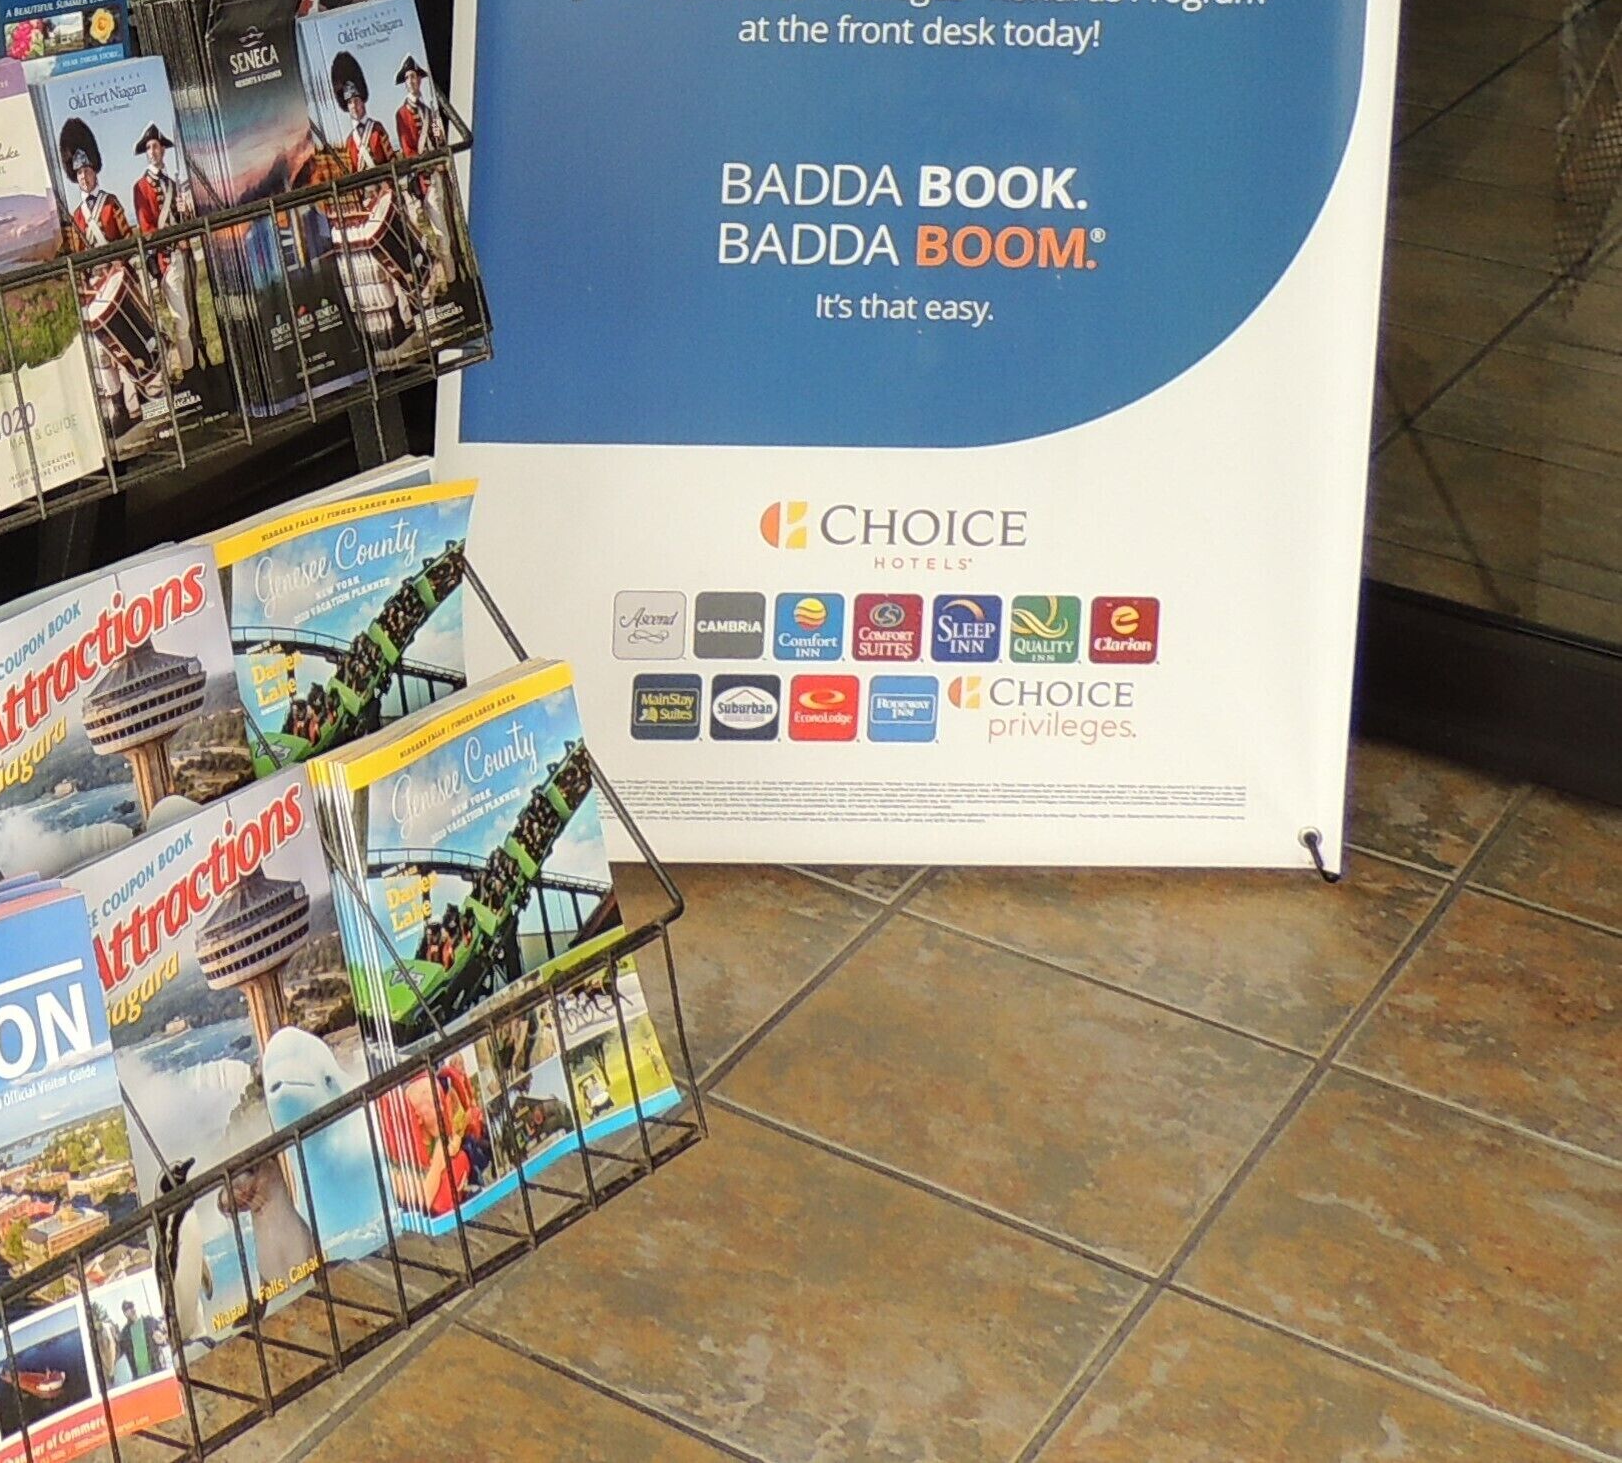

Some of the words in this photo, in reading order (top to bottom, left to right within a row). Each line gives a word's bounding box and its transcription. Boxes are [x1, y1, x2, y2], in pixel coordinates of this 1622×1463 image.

[720, 163, 902, 207] BADDA
[919, 166, 1087, 210] BOOK.
[717, 222, 899, 266] BADDA
[815, 294, 852, 319] It's
[859, 295, 917, 320] that
[925, 300, 994, 327] easy.
[820, 504, 1028, 547] CHOICE
[335, 517, 418, 570] County
[937, 618, 996, 640] SLEEP
[778, 634, 839, 650] Comfort
[859, 640, 912, 658] SUITES
[949, 636, 984, 654] INN
[1014, 638, 1074, 654] QUALITY
[1094, 637, 1152, 653] Clarion
[795, 647, 820, 657] INN
[640, 692, 694, 708] MainStay
[989, 678, 1133, 707] CHOICE
[717, 702, 773, 716] Suburban
